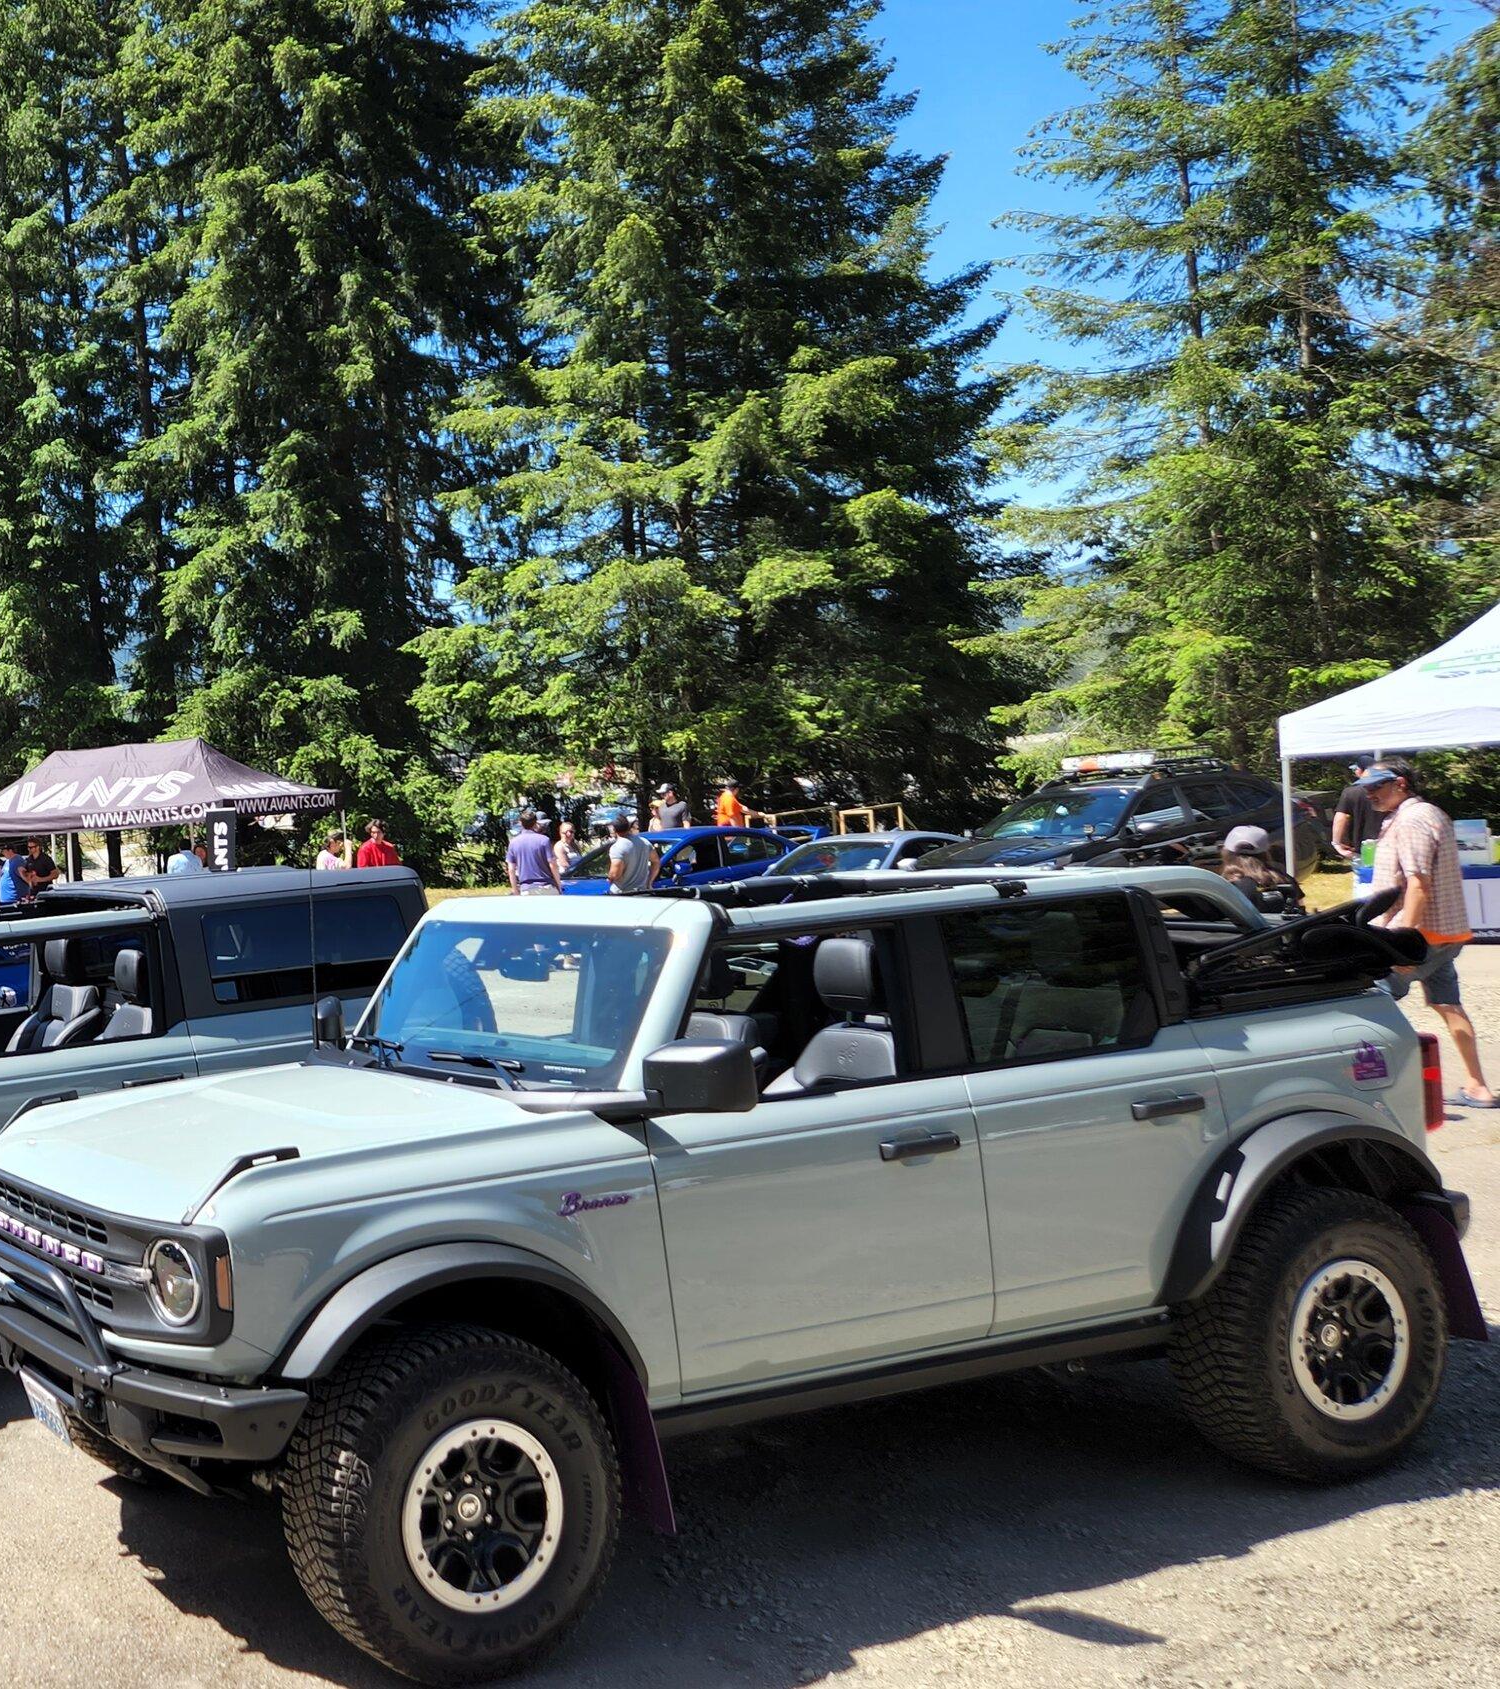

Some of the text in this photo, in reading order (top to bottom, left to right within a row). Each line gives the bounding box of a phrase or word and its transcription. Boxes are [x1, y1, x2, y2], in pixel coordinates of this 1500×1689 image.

[81, 801, 217, 828] WWW.AVANTS.COM
[234, 793, 336, 814] WWW.AVANTS.COM
[557, 1191, 632, 1216] Bronco
